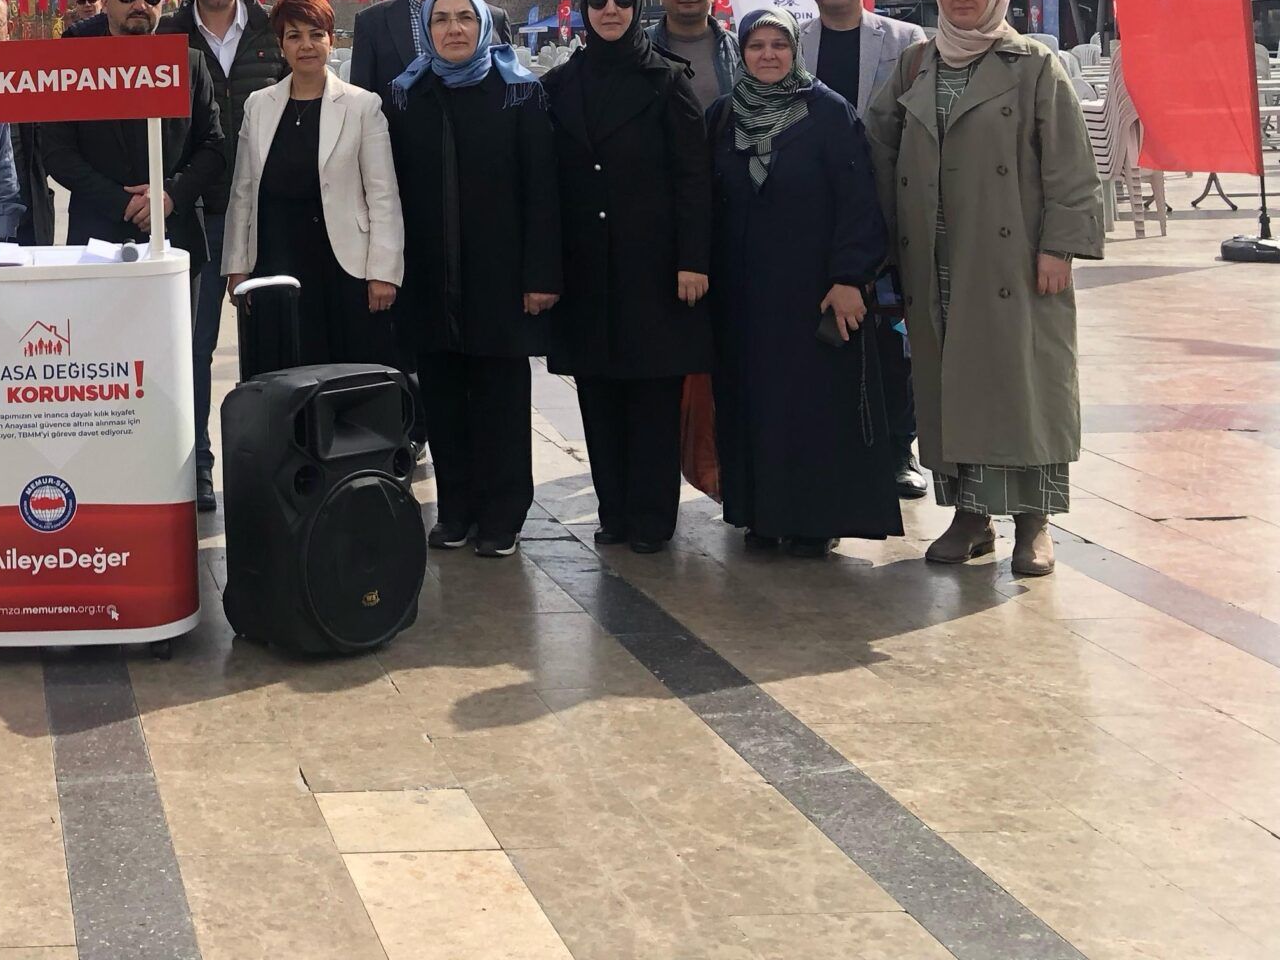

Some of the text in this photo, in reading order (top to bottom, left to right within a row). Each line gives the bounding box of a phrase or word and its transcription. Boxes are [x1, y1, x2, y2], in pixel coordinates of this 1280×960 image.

[43, 361, 129, 380] DEĞİŞSİN
[7, 383, 130, 404] KORUNSUN
[70, 411, 92, 420] dayalı
[110, 409, 135, 418] kıyafet
[39, 421, 71, 429] güvence
[127, 418, 141, 426] için
[51, 430, 76, 438] göreve
